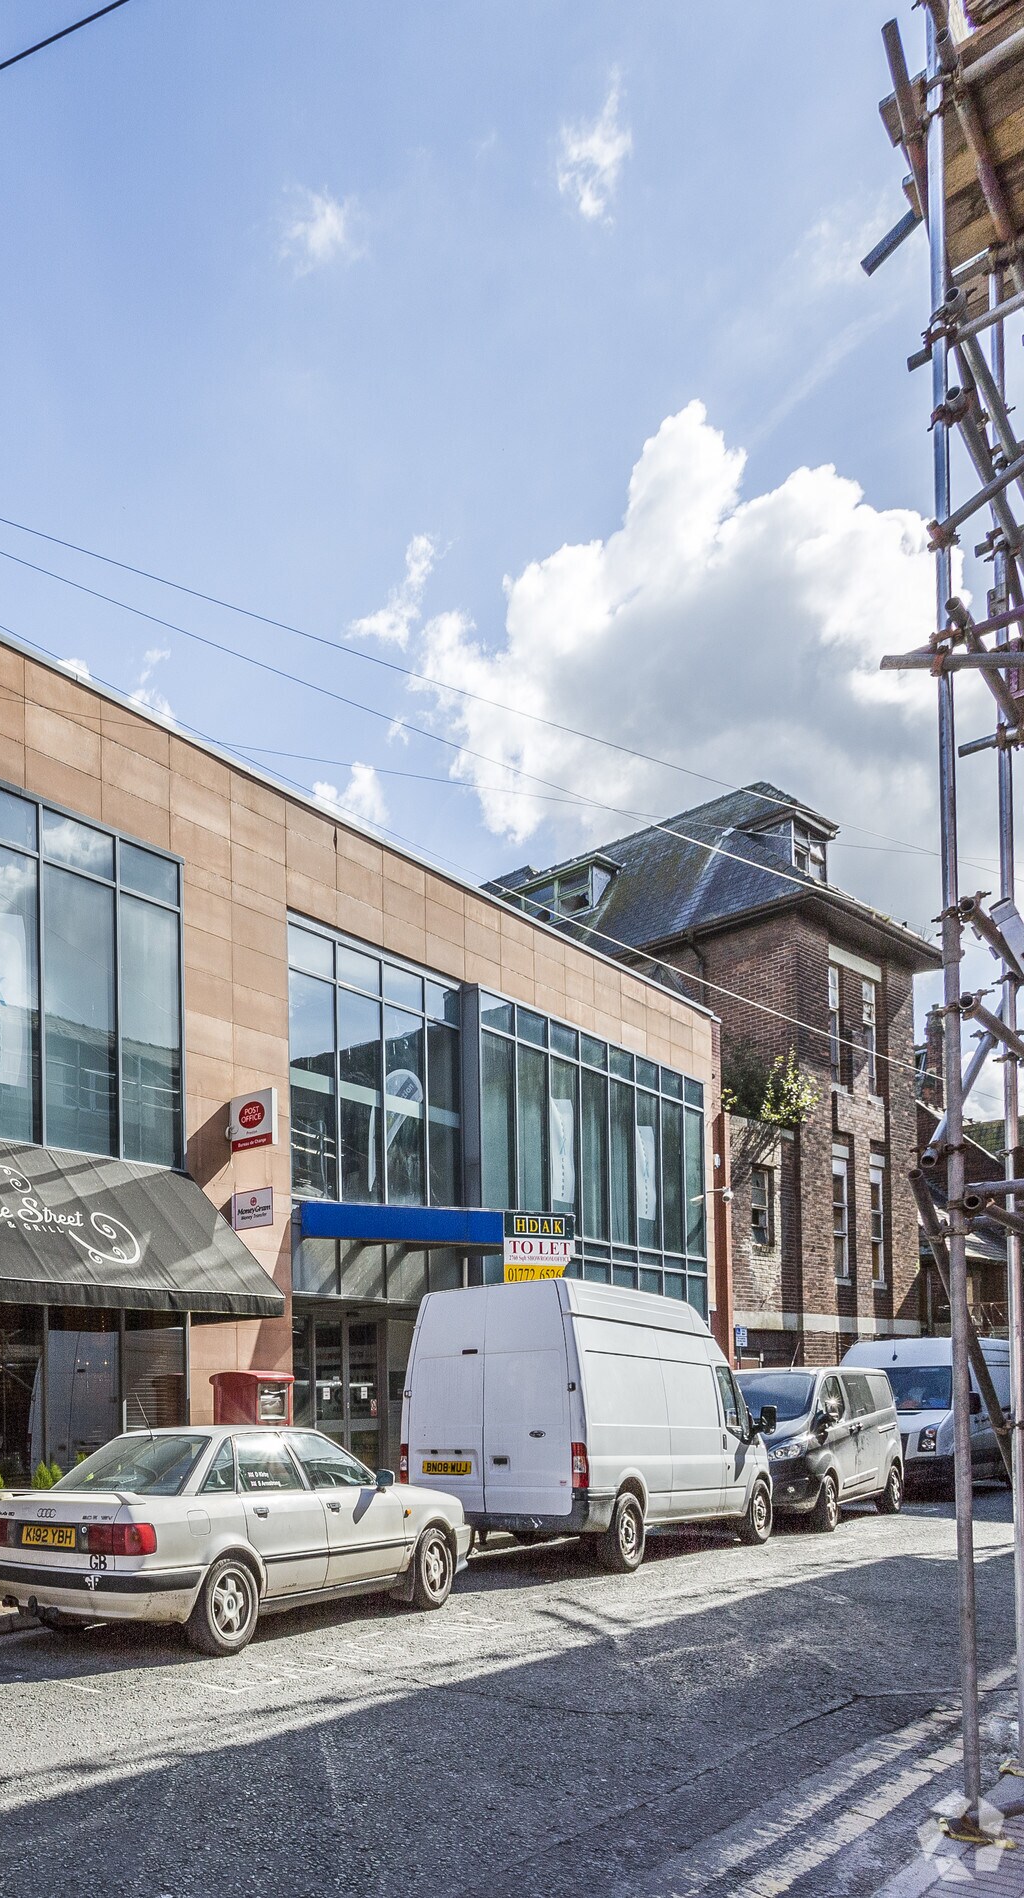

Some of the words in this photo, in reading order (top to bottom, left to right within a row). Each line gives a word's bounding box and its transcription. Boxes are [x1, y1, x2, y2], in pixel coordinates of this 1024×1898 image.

[244, 1105, 260, 1116] POST
[240, 1112, 262, 1124] OFFICE
[17, 1197, 84, 1227] Street
[237, 1205, 271, 1216] MoneyGram
[7, 1221, 17, 1229] &
[23, 1223, 65, 1234] GRILL
[516, 1219, 563, 1233] HDAK
[509, 1240, 534, 1255] TO
[539, 1241, 571, 1256] LET
[507, 1267, 536, 1282] 01772
[539, 1268, 565, 1280] 6526
[426, 1462, 449, 1473] BN08
[25, 1527, 49, 1543] K192
[51, 1529, 73, 1545] YBH
[89, 1554, 107, 1570] GB
